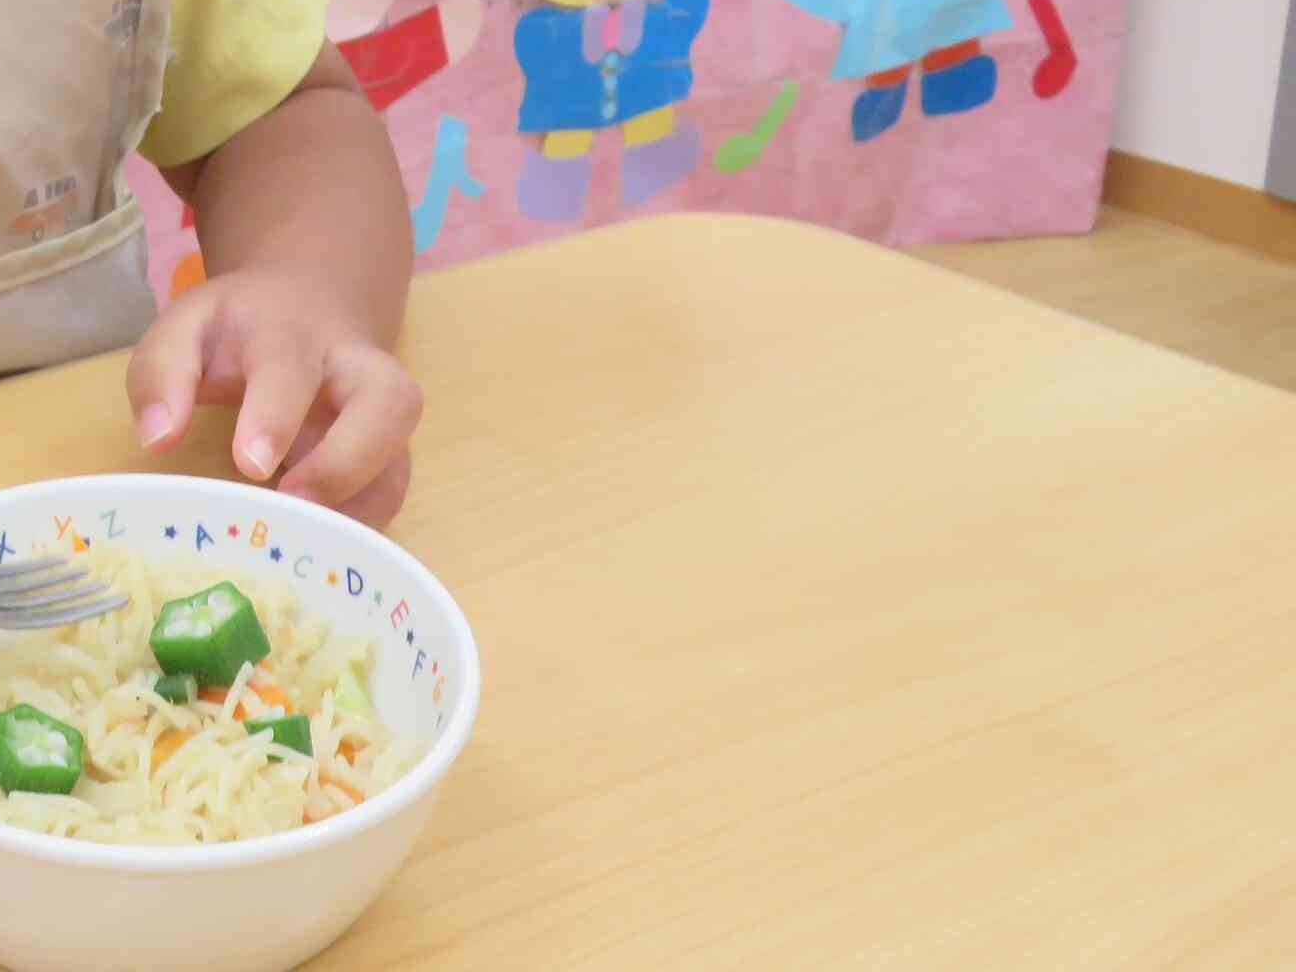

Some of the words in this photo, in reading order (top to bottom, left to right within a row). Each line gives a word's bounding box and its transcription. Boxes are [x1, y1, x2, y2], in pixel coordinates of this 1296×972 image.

[53, 515, 73, 541] Y
[99, 507, 128, 540] Z
[195, 522, 216, 552] A
[249, 519, 268, 549] B
[293, 554, 313, 579] C
[346, 566, 364, 596] D
[389, 598, 410, 629] E
[411, 648, 427, 680] F
